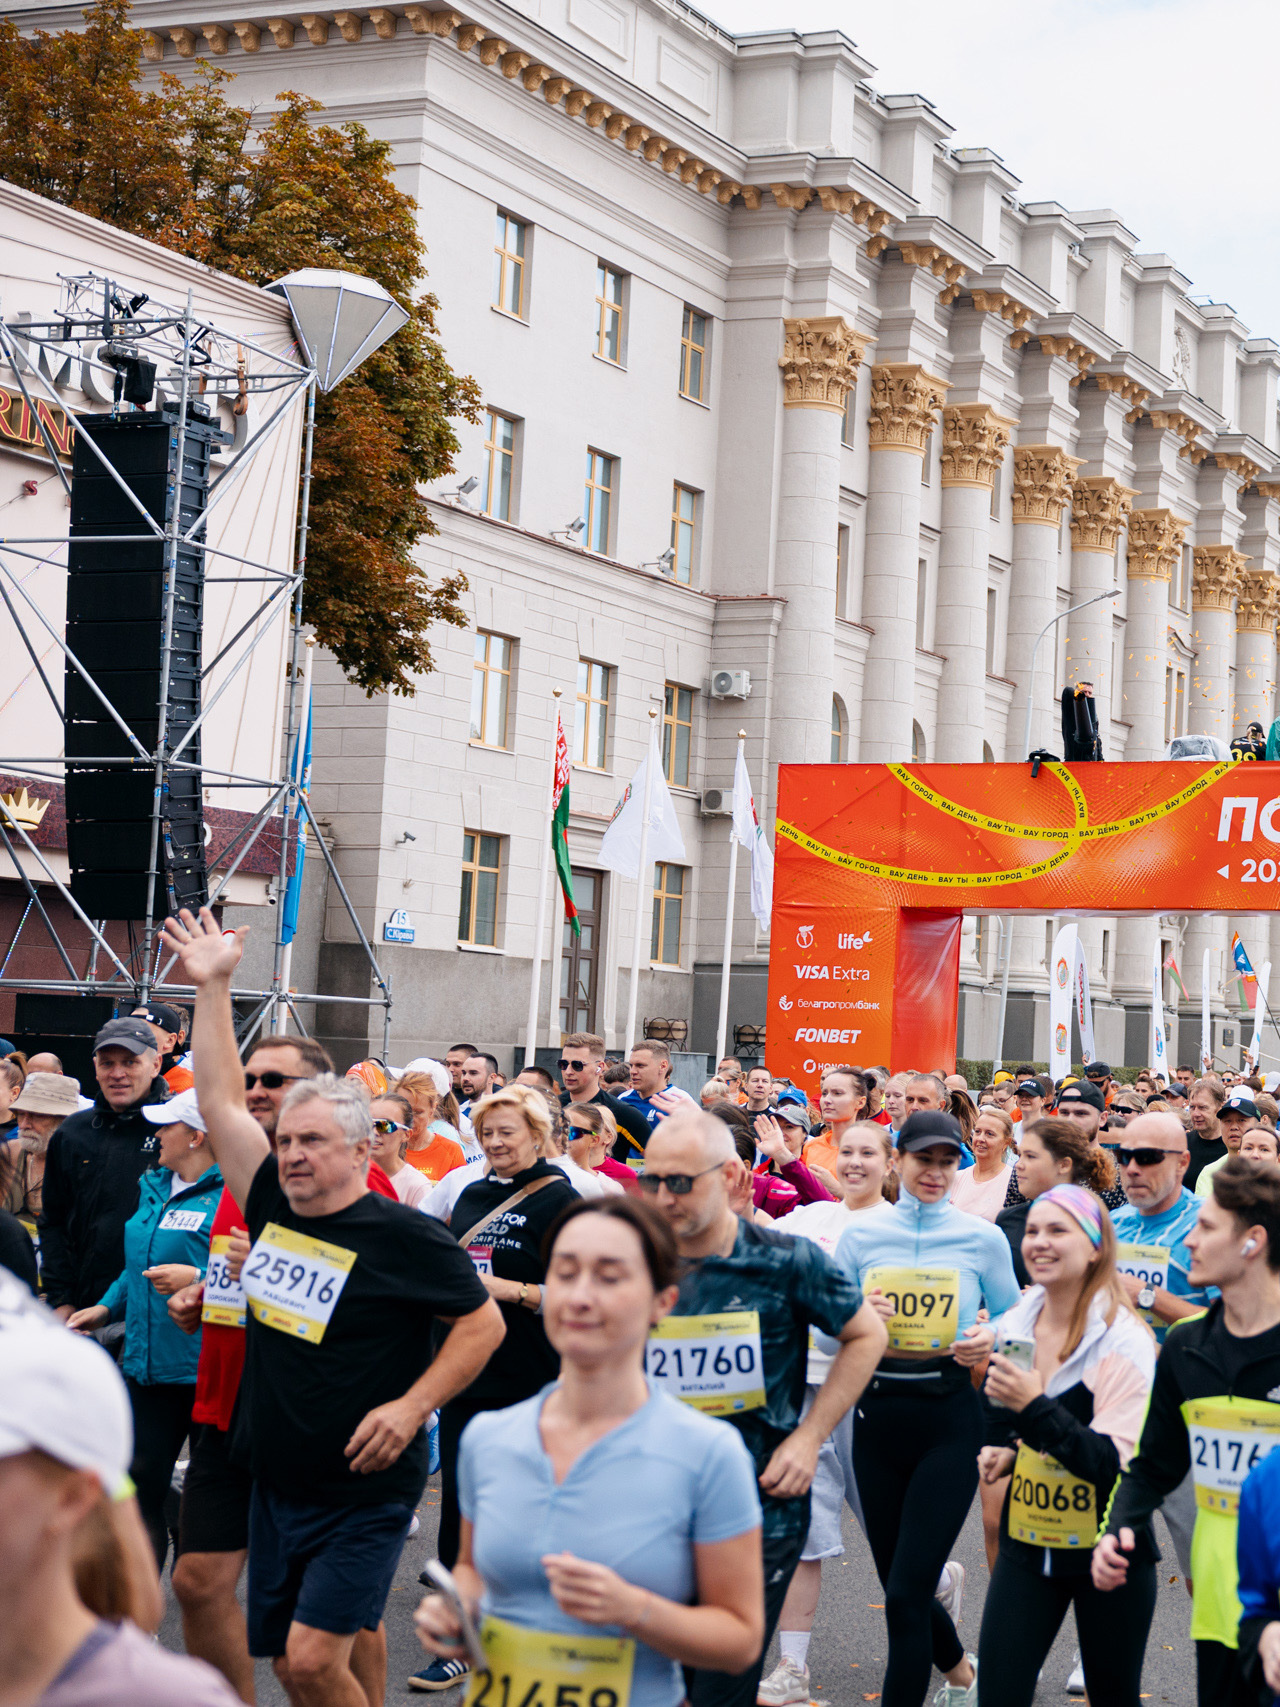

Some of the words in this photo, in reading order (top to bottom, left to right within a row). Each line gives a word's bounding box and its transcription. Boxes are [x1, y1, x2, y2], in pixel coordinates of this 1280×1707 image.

[1056, 768, 1070, 782] ВАУ
[1072, 787, 1081, 800] ТЫ
[896, 768, 911, 782] ВАУ
[911, 781, 934, 802] ГОРОД
[940, 801, 956, 812] ВАУ
[956, 810, 978, 822] ДЕНЬ
[987, 820, 1002, 830] ВАУ
[1004, 825, 1016, 834] ТЫ
[1079, 829, 1095, 838] ВАУ
[1098, 825, 1120, 836] ДЕНЬ
[1129, 816, 1145, 826] ВАУ
[1145, 810, 1158, 820] ТЫ
[1165, 798, 1180, 811] ВАУ
[1182, 779, 1208, 800] ГОРОД
[779, 824, 799, 840] ДЕНЬ
[806, 840, 820, 851] ВАУ
[820, 848, 832, 858] ТЫ
[1050, 850, 1070, 868] ДЕНЬ
[838, 856, 852, 866] ВАУ
[855, 861, 880, 874] ГОРОД
[889, 870, 904, 878] ВАУ
[1031, 864, 1047, 874] ВАУ
[907, 872, 928, 882] ДЕНЬ
[996, 872, 1022, 882] ГОРОД
[397, 912, 406, 925] 15
[838, 933, 864, 950] life
[793, 965, 830, 980] VISA
[832, 966, 870, 980] Extra
[798, 998, 880, 1010] белагропромбанк
[794, 1028, 862, 1044] FONBET
[502, 1212, 527, 1228] FOR
[472, 1235, 522, 1249] ORIFLAME
[206, 1262, 242, 1292] 58
[246, 1252, 336, 1304] 25916
[886, 1292, 954, 1318] 0097
[652, 1344, 755, 1377] 21760
[1194, 1436, 1262, 1472] 2176
[1014, 1474, 1091, 1512] 20068
